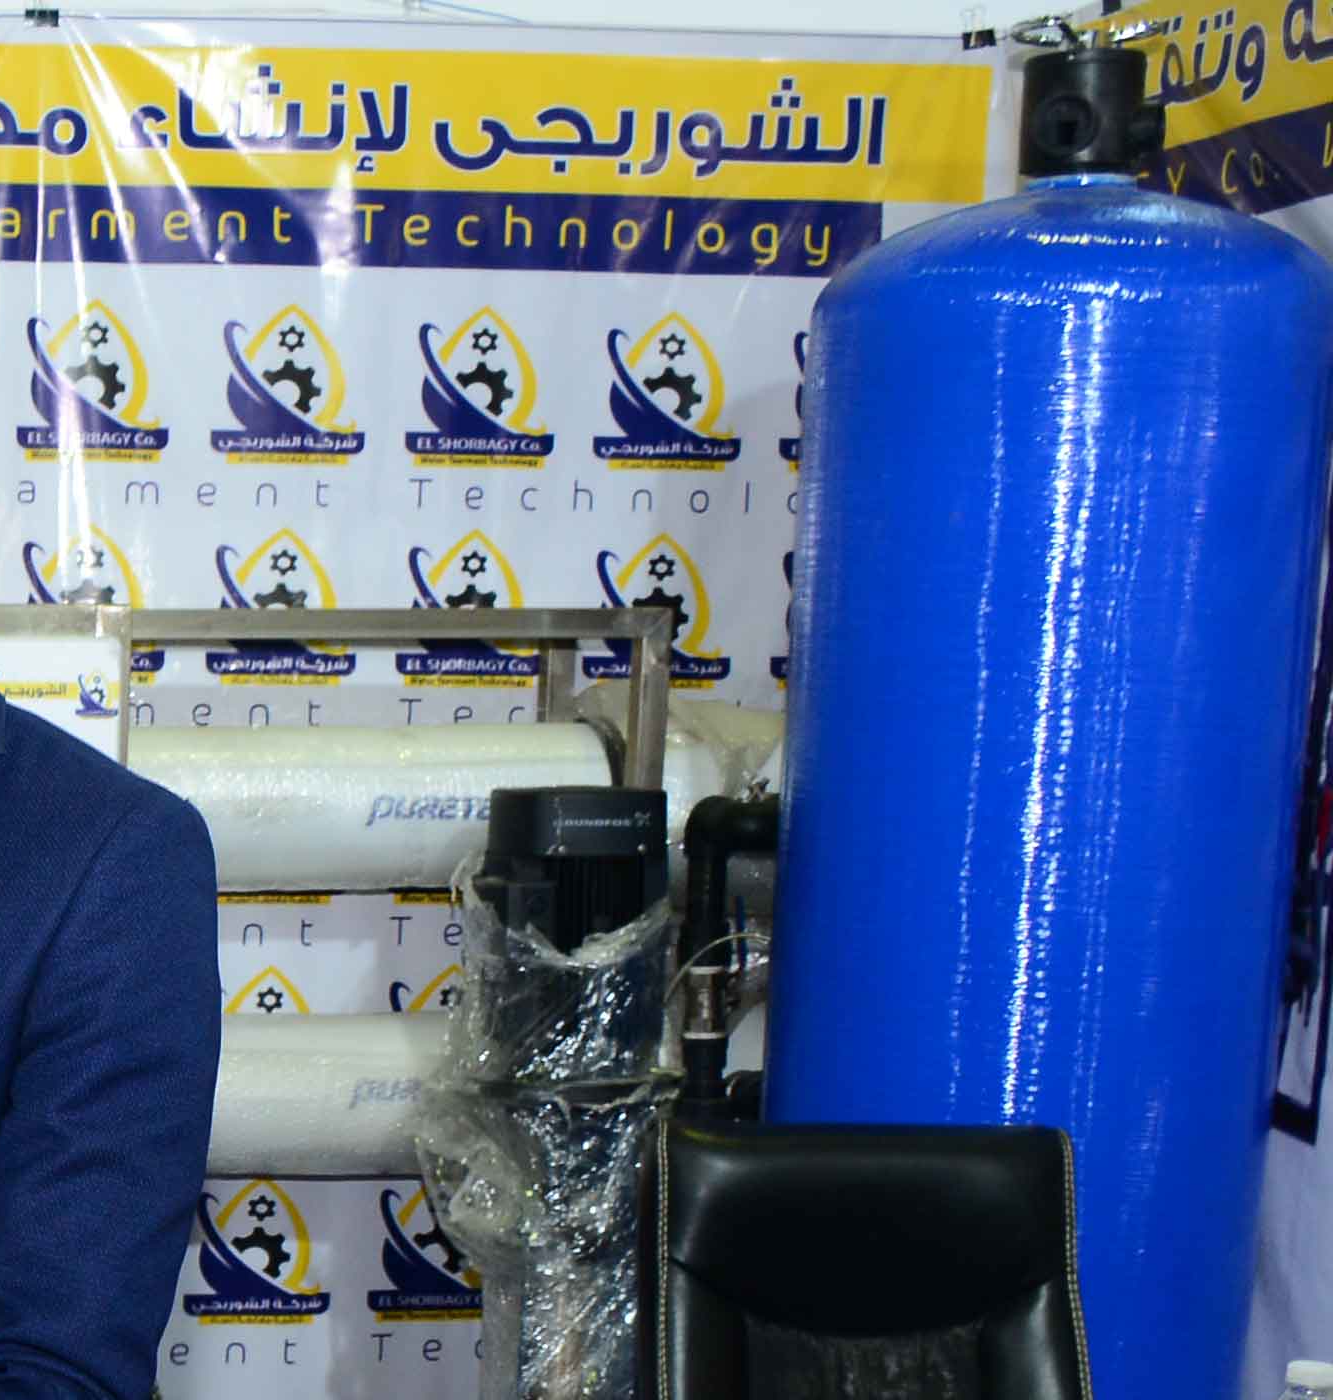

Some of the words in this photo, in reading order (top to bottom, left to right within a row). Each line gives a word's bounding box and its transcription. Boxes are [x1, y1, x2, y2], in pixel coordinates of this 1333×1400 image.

[119, 64, 410, 174] لإنشاء
[433, 76, 887, 179] الشوربجى
[358, 204, 832, 267] Technology
